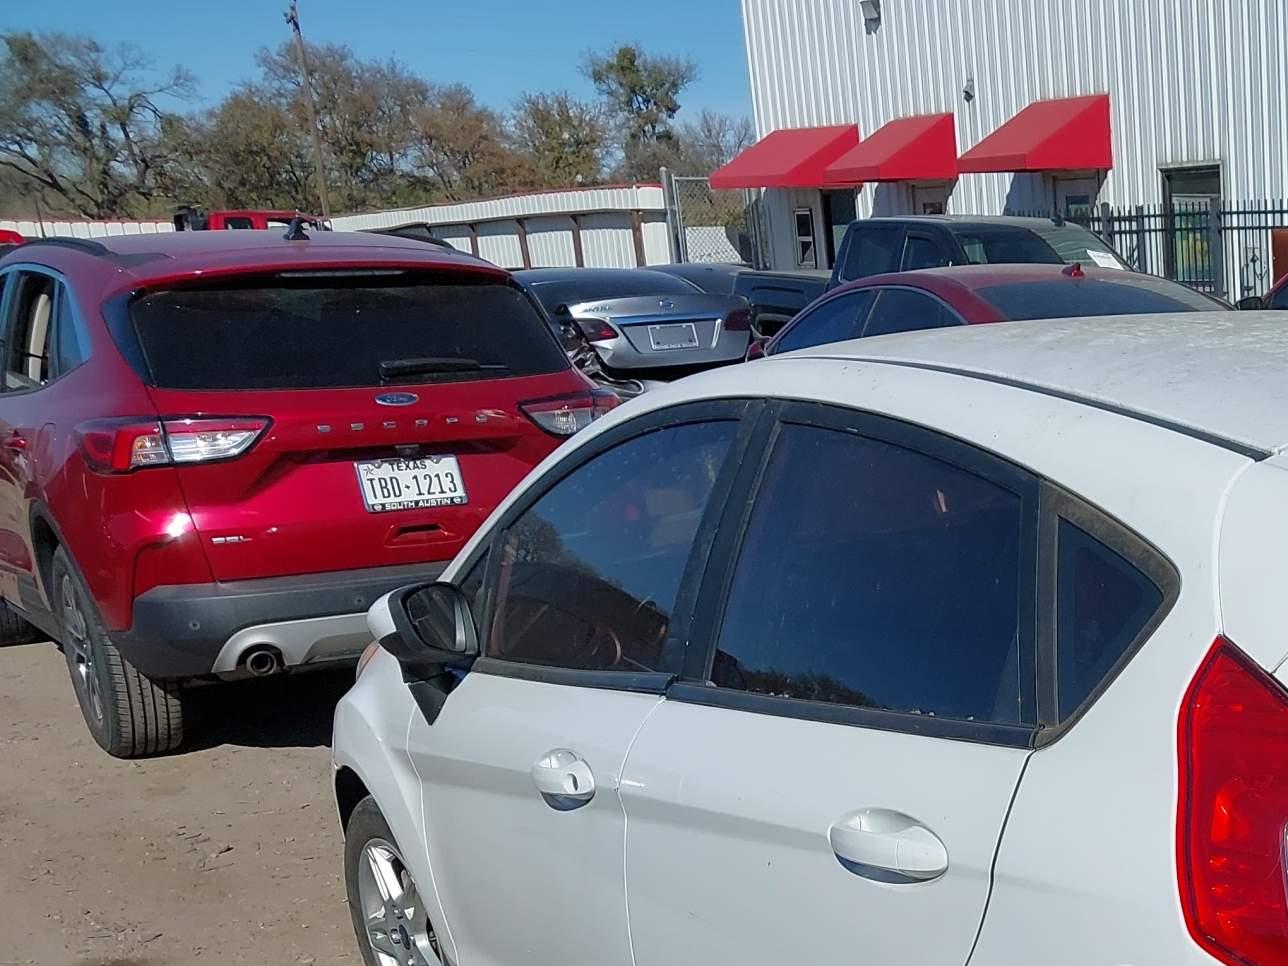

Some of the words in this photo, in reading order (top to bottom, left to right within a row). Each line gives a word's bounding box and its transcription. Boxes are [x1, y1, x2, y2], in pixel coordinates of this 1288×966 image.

[388, 460, 427, 472] TEXAS
[385, 501, 416, 511] SOUTH
[418, 497, 451, 507] AUSTIN
